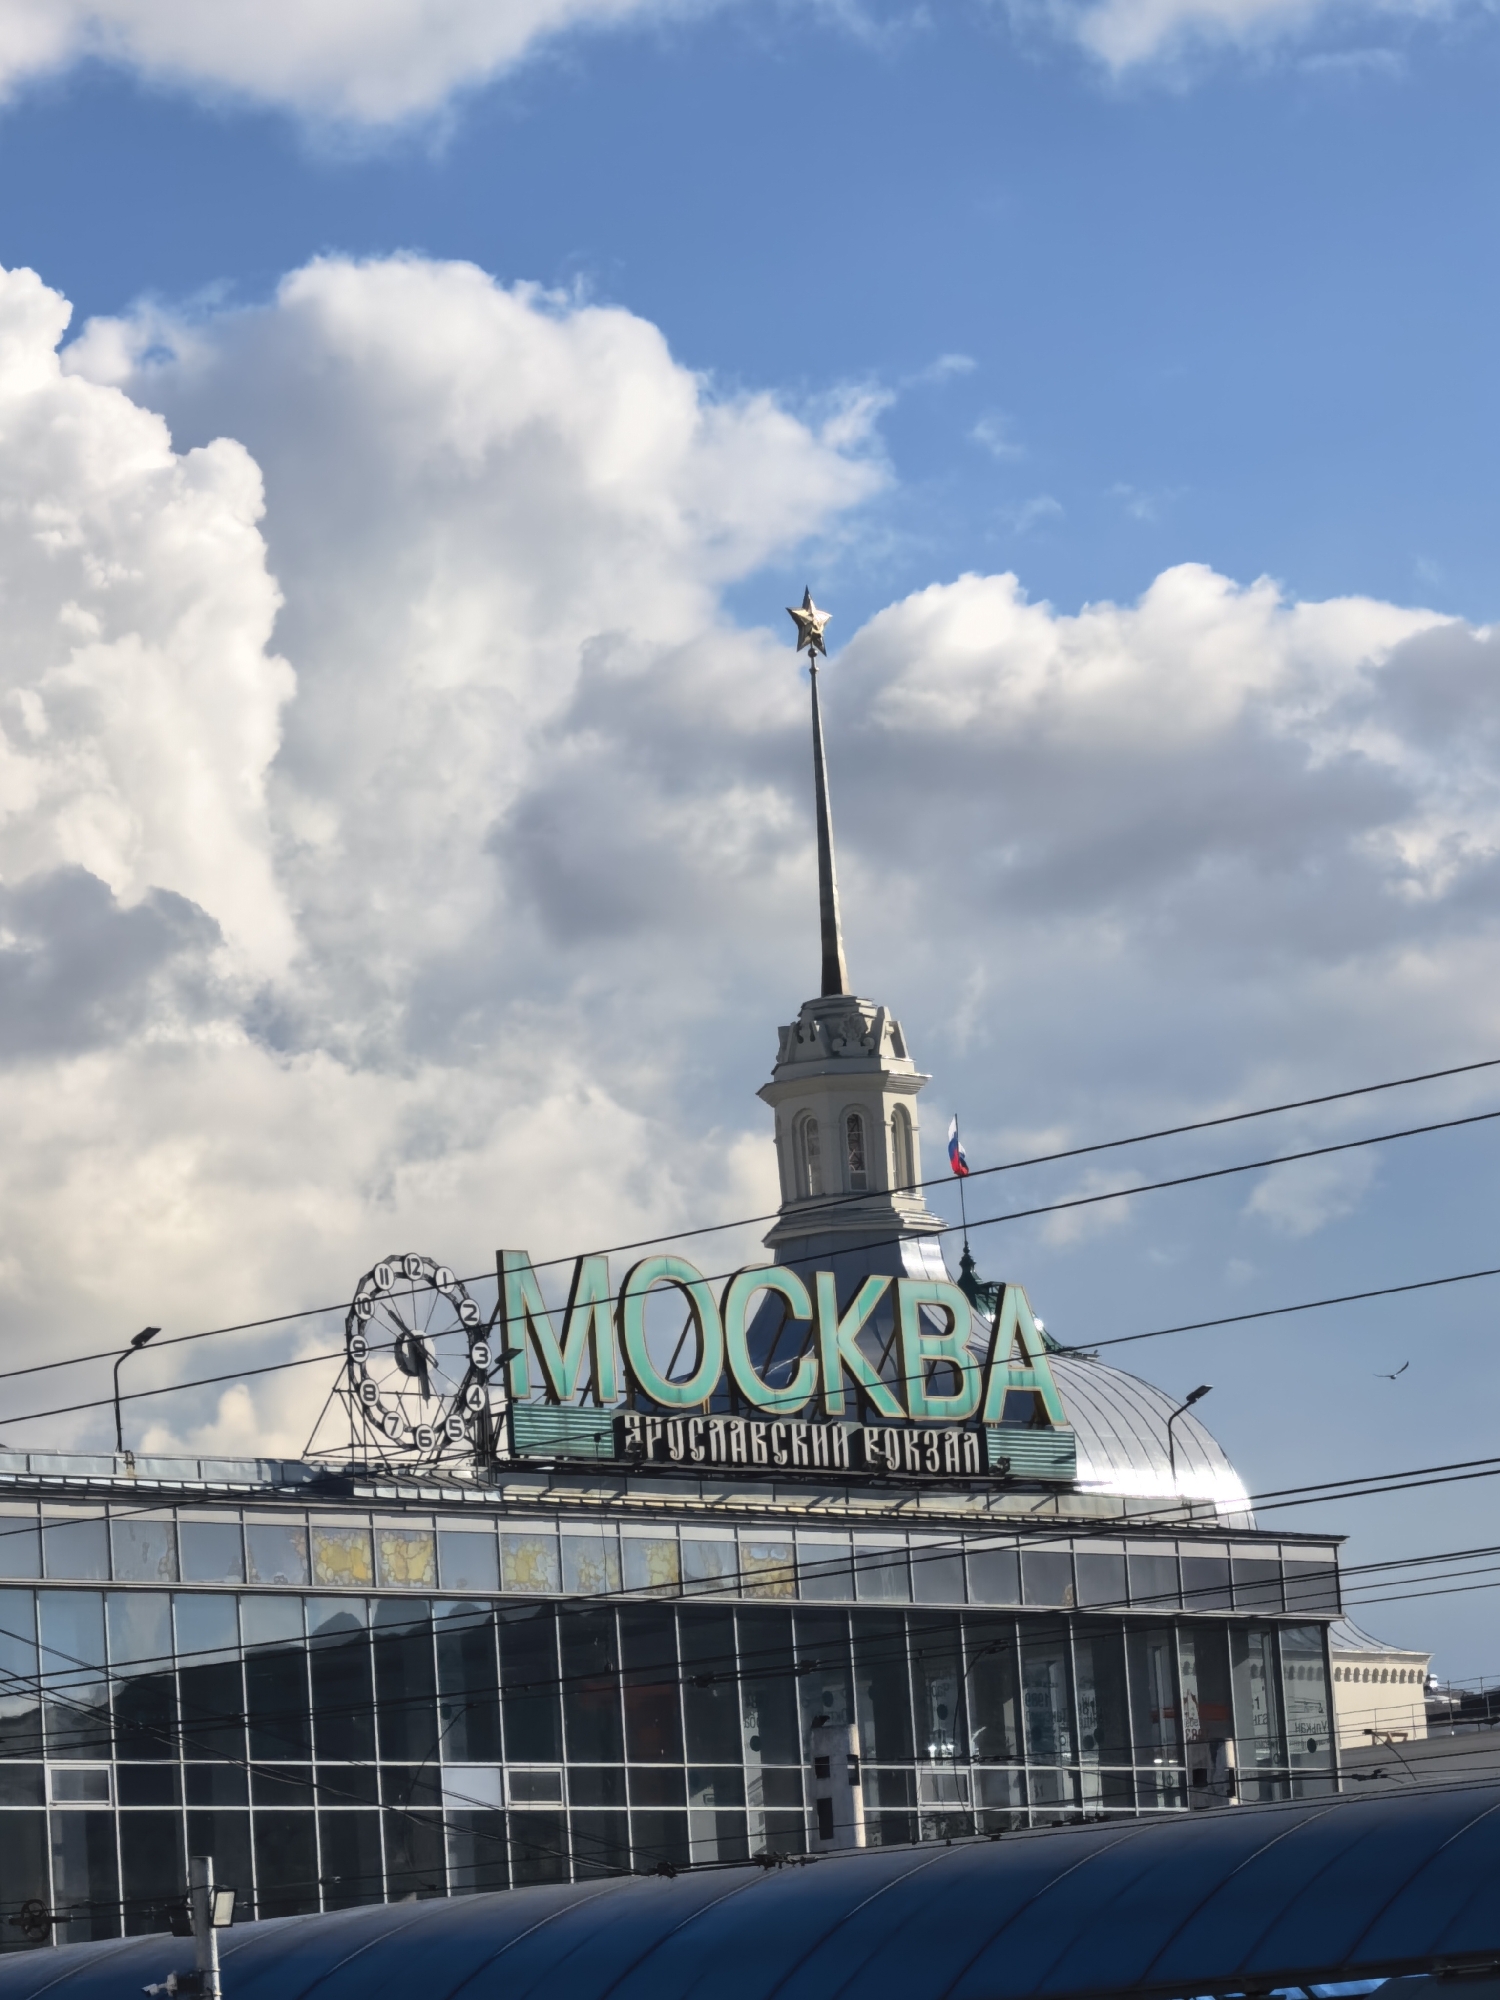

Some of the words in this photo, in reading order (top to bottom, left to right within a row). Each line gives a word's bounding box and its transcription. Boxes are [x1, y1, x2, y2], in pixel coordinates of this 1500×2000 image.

[378, 1267, 389, 1285] 11
[407, 1257, 422, 1276] 12
[357, 1297, 372, 1315] 10
[462, 1303, 478, 1322] 2
[496, 1249, 1069, 1426] МОСКВА
[352, 1339, 366, 1358] 9
[475, 1346, 489, 1364] 3
[362, 1384, 377, 1402] 8
[468, 1388, 482, 1407] 4
[387, 1416, 400, 1436] 7
[449, 1419, 462, 1437] 5
[418, 1429, 432, 1448] 6
